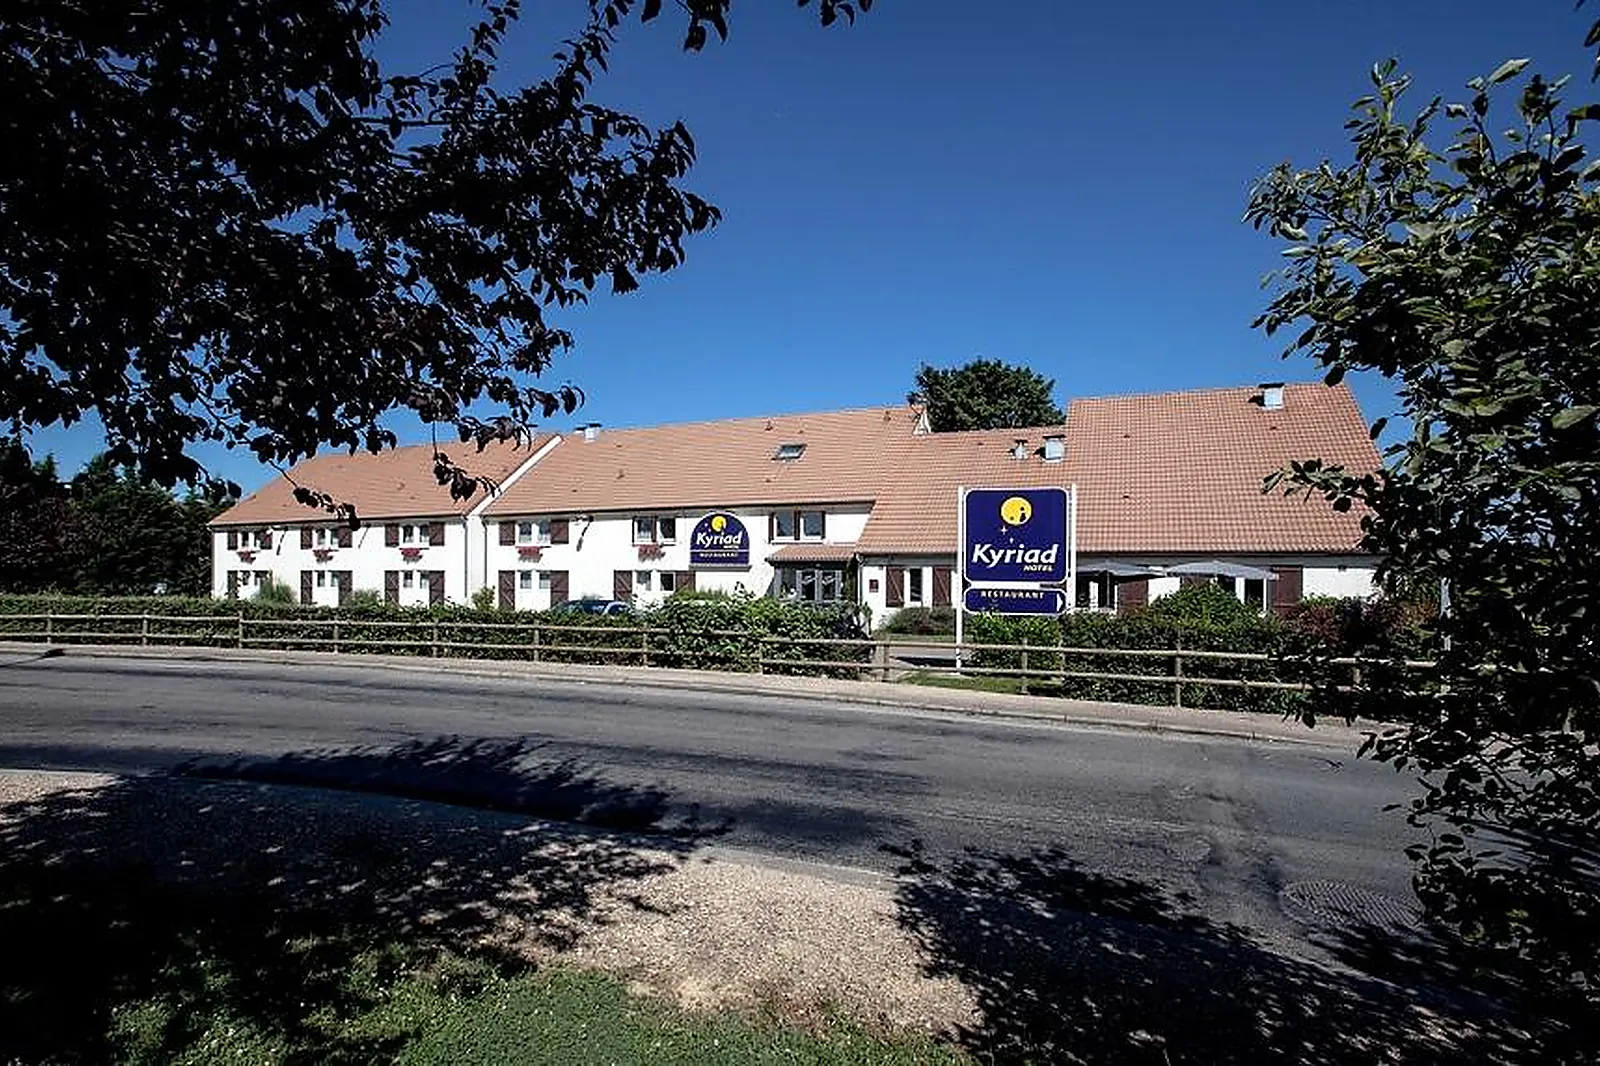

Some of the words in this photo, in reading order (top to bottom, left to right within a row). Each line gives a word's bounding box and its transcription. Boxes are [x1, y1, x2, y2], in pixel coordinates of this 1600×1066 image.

[696, 531, 743, 548] Kyriad
[971, 543, 1059, 569] Kyriad
[980, 590, 1044, 599] RESTAURANT
